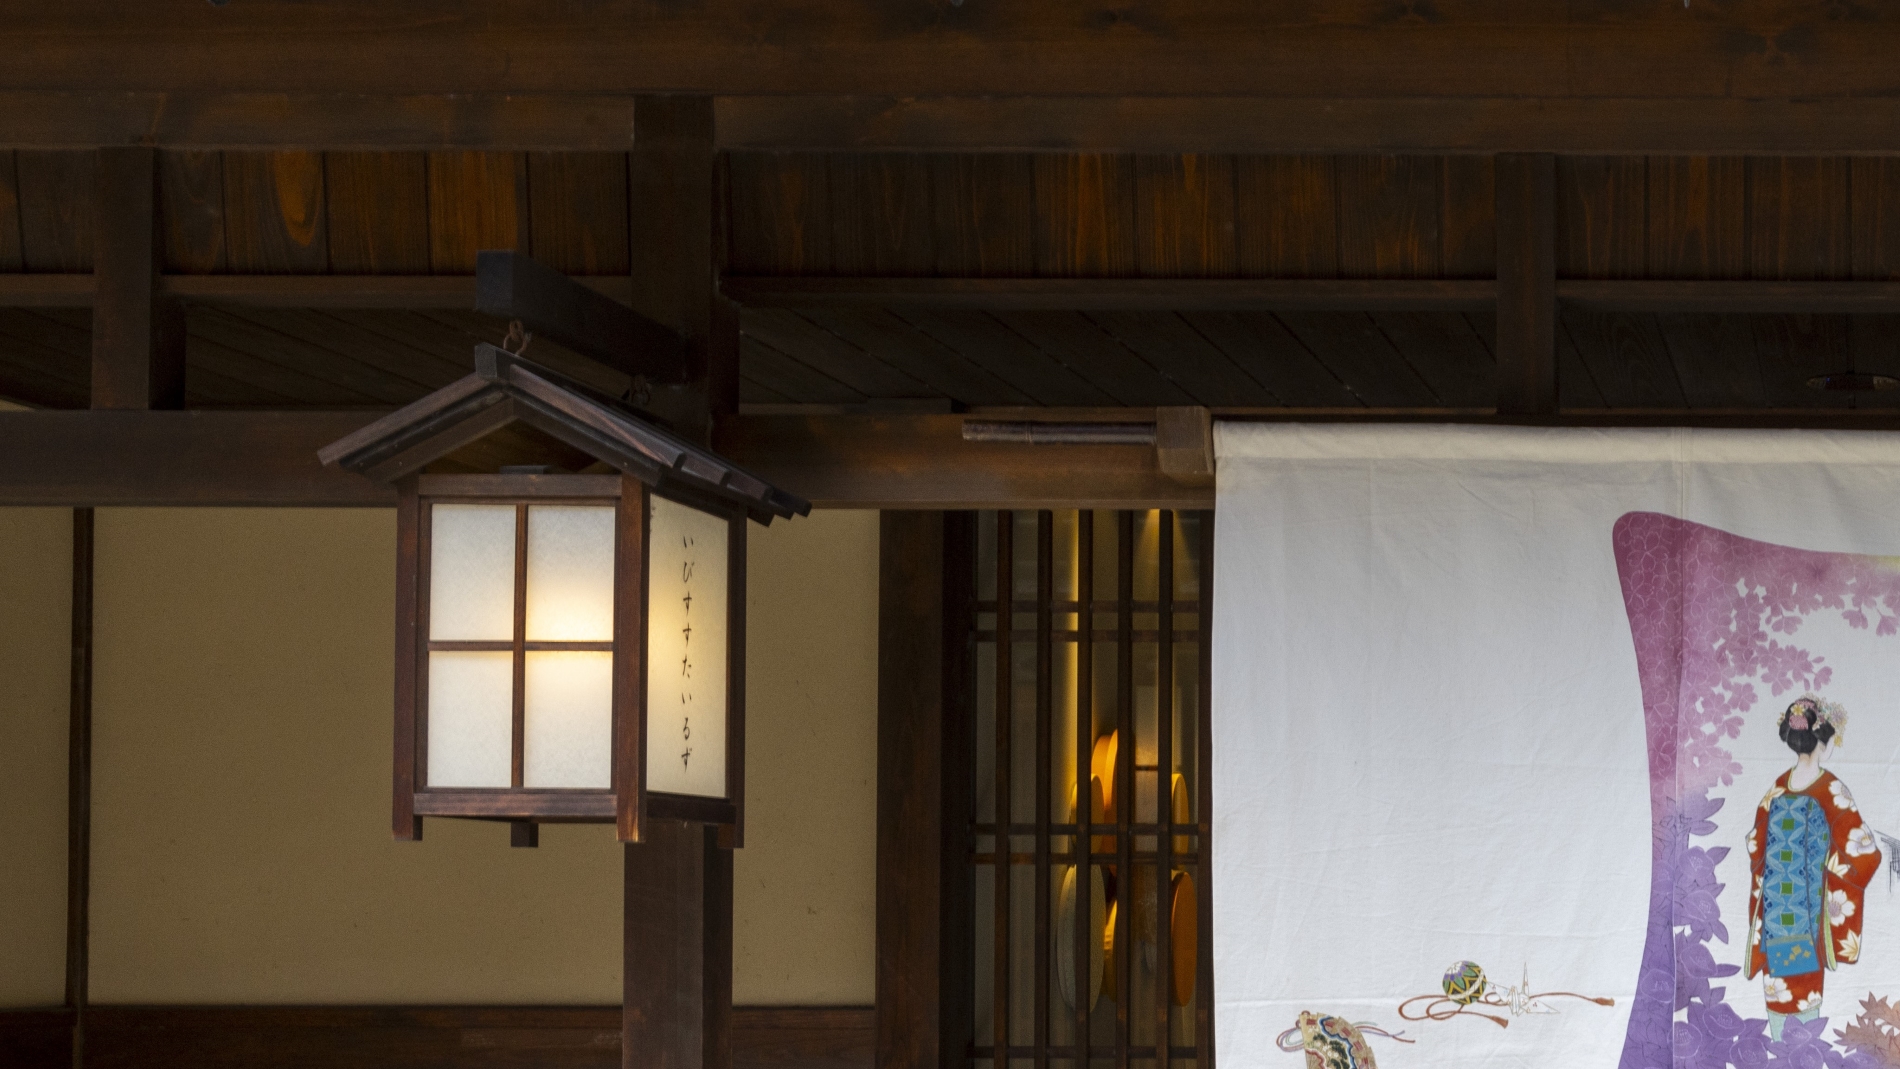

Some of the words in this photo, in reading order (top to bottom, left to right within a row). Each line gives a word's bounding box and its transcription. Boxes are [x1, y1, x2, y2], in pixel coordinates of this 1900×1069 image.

[681, 535, 695, 774] いびすすたいるず
